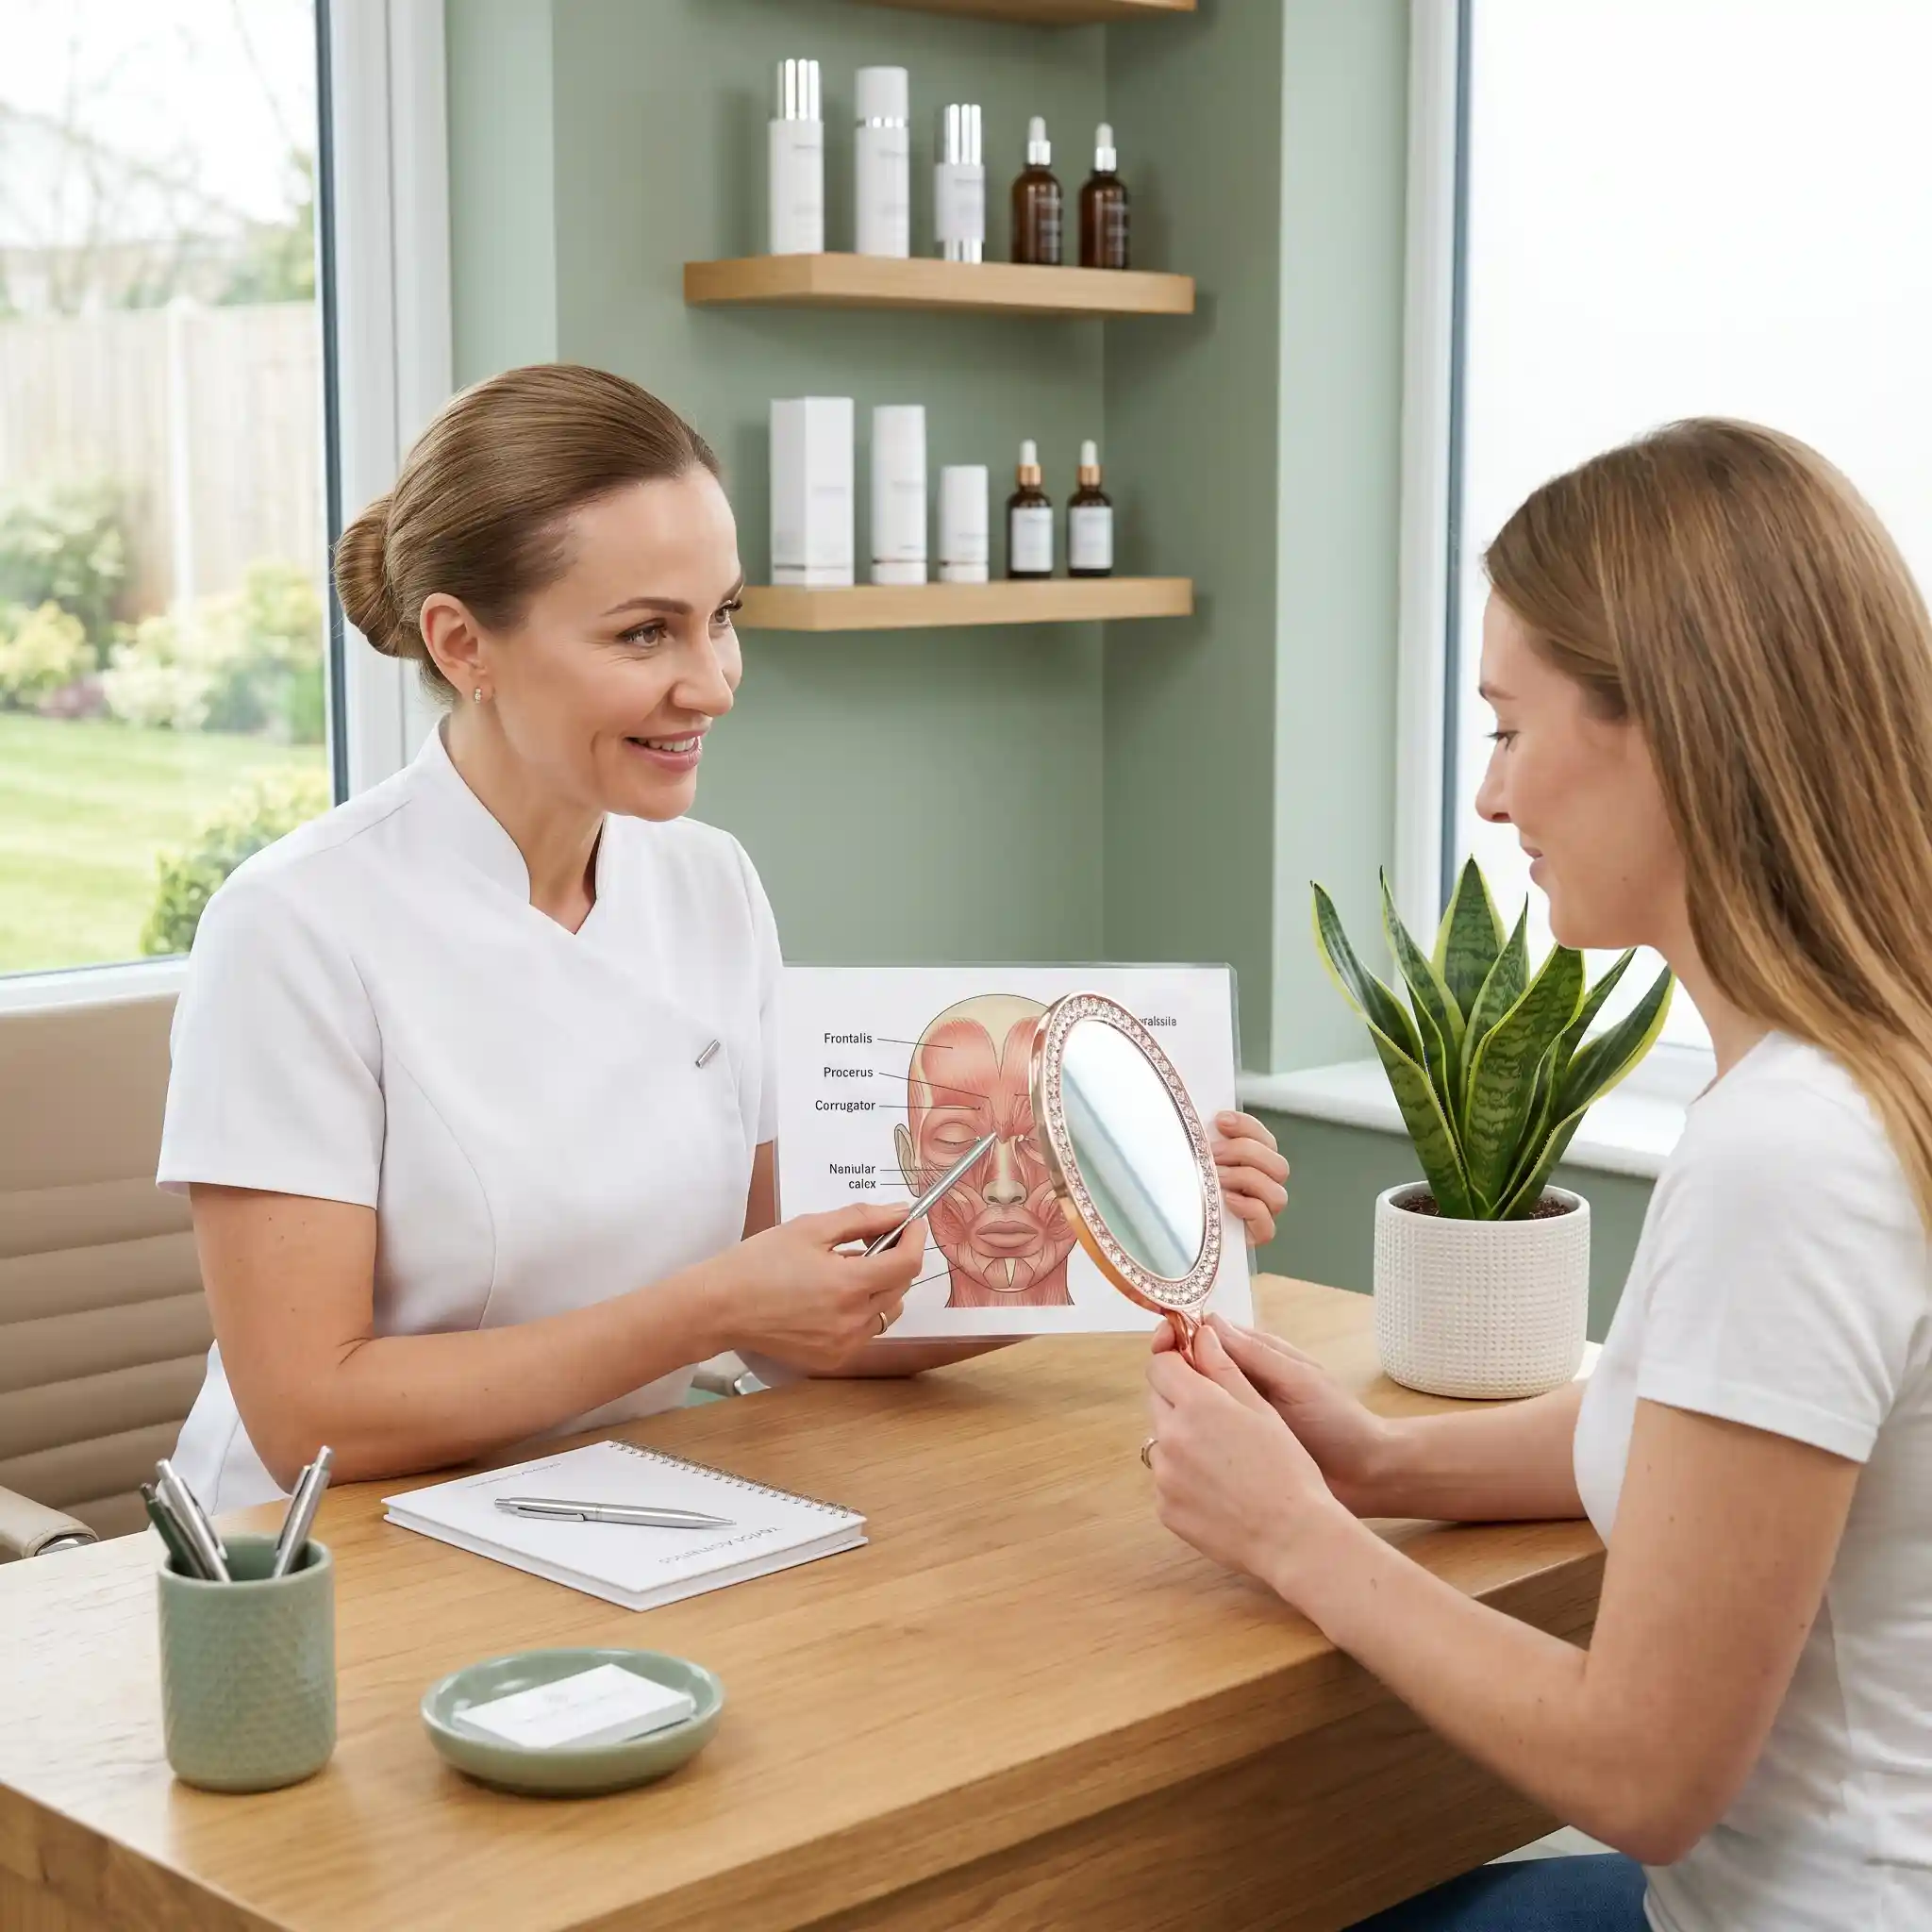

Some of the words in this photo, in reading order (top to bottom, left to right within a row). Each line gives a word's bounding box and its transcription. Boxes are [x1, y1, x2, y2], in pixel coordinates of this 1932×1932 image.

[824, 1032, 873, 1044] Frontalis
[824, 1066, 874, 1078] Procerus
[815, 1099, 876, 1113] Corrugator
[848, 1178, 876, 1190] calex
